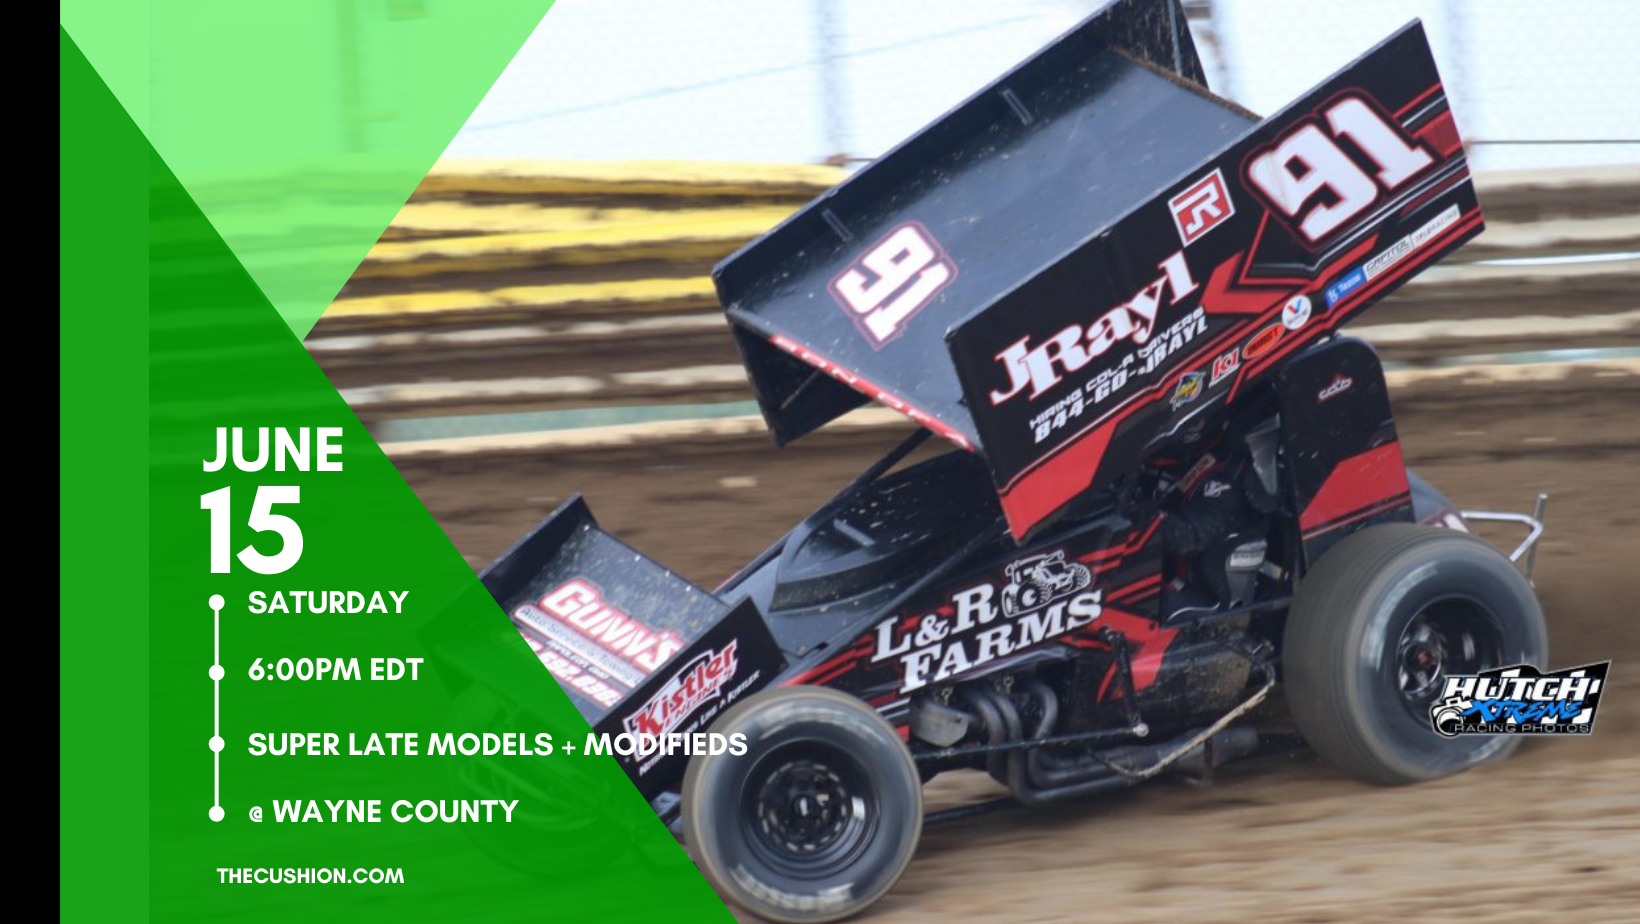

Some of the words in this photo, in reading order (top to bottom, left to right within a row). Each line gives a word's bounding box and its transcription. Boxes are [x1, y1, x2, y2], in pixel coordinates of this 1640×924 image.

[1247, 97, 1435, 243] 91
[834, 225, 951, 343] 91
[989, 250, 1199, 406] JRayl
[1029, 388, 1083, 429] HIRING
[1137, 306, 1205, 359] DRIVERS
[870, 583, 999, 663] L&R
[899, 588, 1104, 695] FARMS
[634, 640, 737, 748] Kistler
